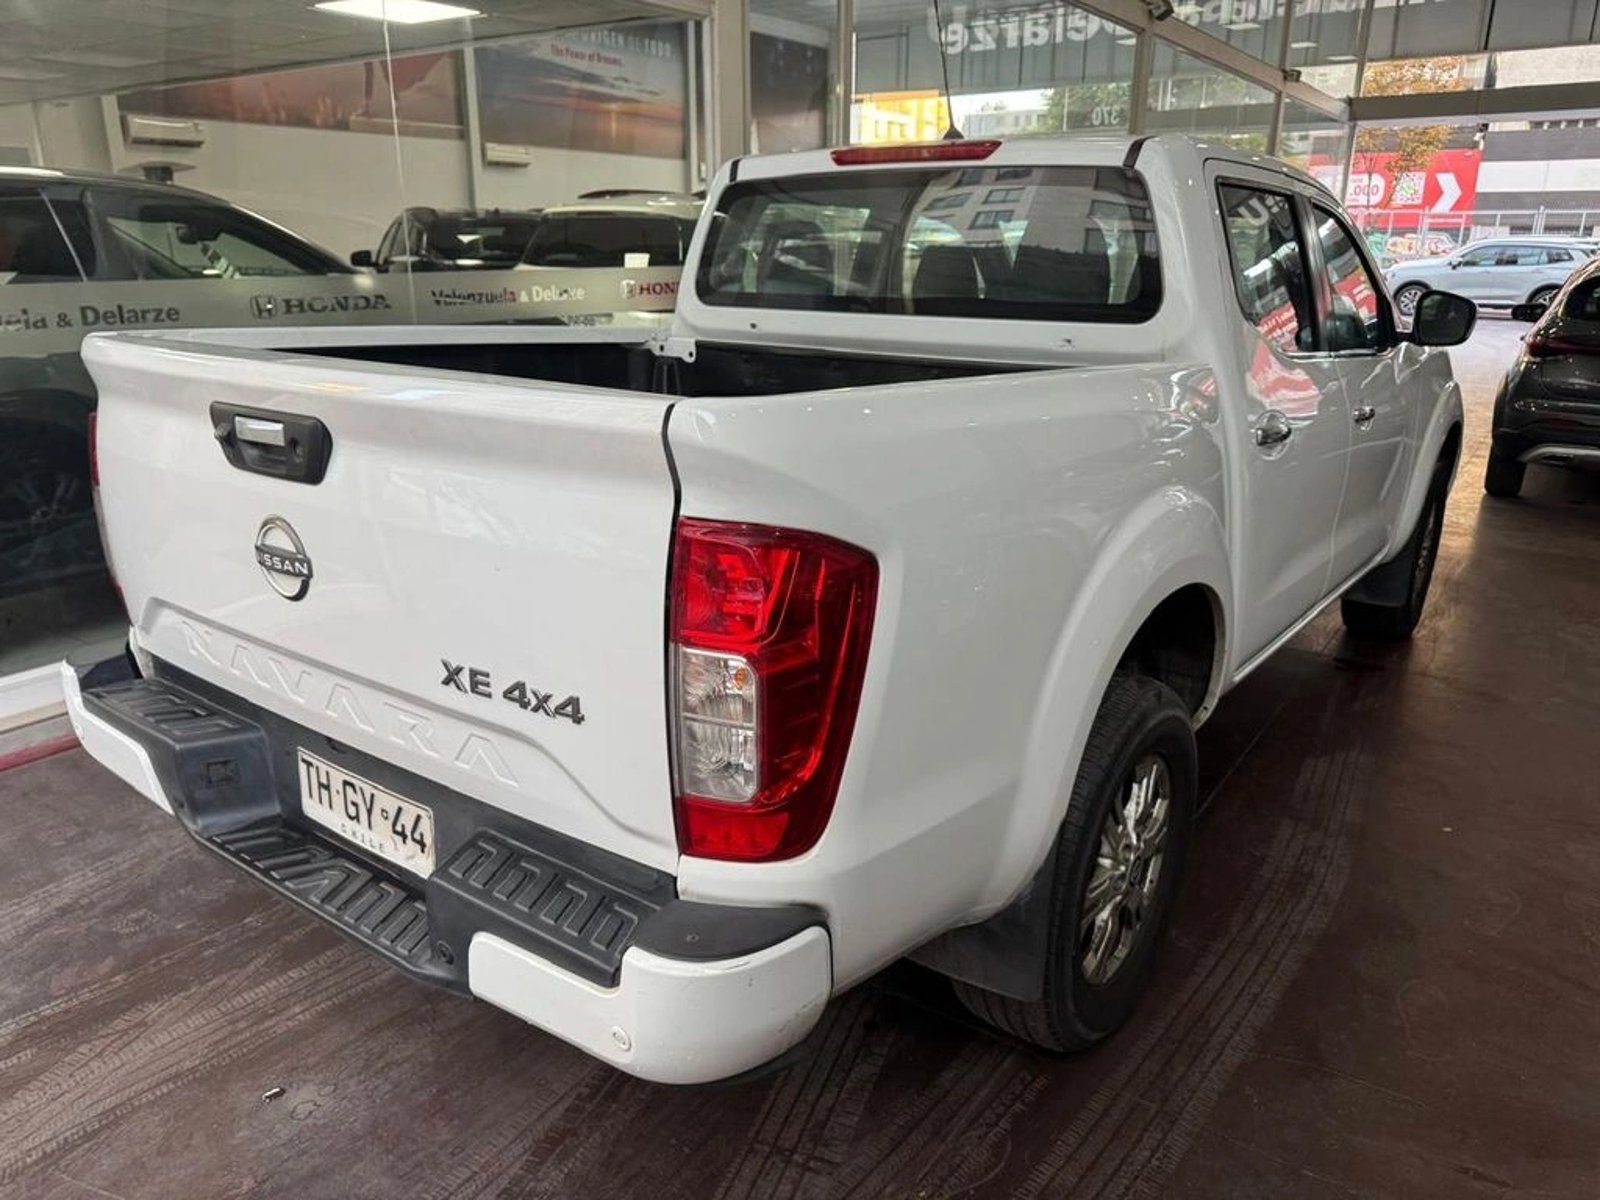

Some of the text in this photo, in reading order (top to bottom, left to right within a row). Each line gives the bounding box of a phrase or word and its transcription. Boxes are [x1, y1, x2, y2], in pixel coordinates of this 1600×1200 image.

[80, 303, 181, 327] Delarze
[282, 294, 391, 315] HONDA
[180, 619, 519, 789] NAVARA
[440, 658, 586, 726] XE 4x4
